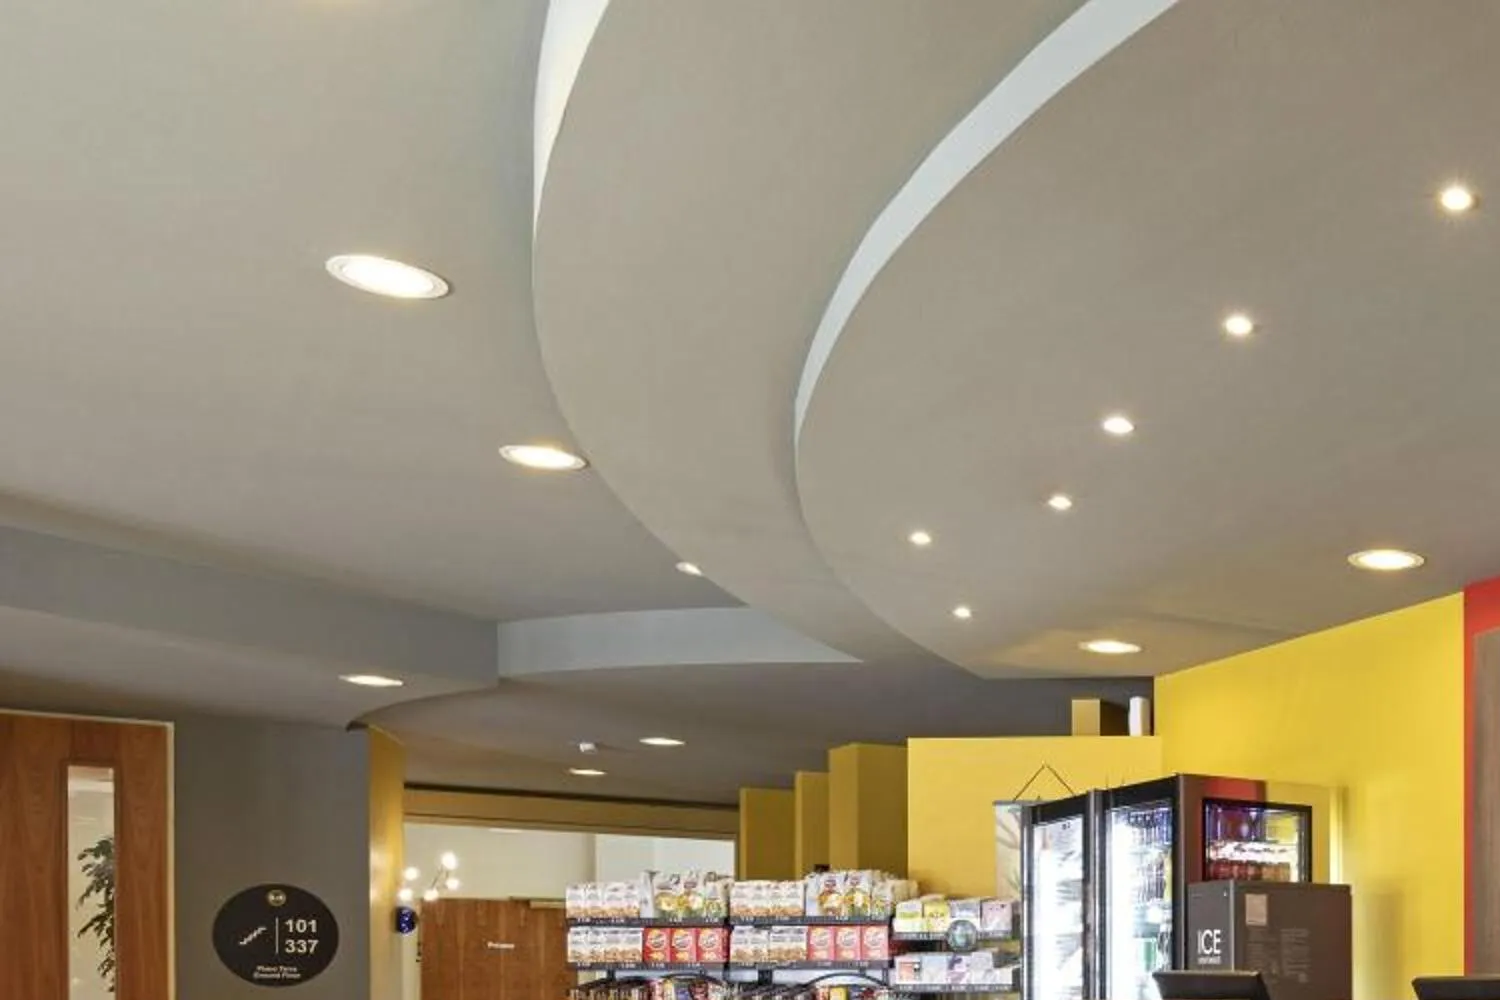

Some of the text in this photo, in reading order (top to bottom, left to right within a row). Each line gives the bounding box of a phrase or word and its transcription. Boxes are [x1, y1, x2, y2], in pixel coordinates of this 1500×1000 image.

[285, 919, 318, 933] 101
[285, 939, 319, 954] 337
[1197, 929, 1222, 955] ICE
